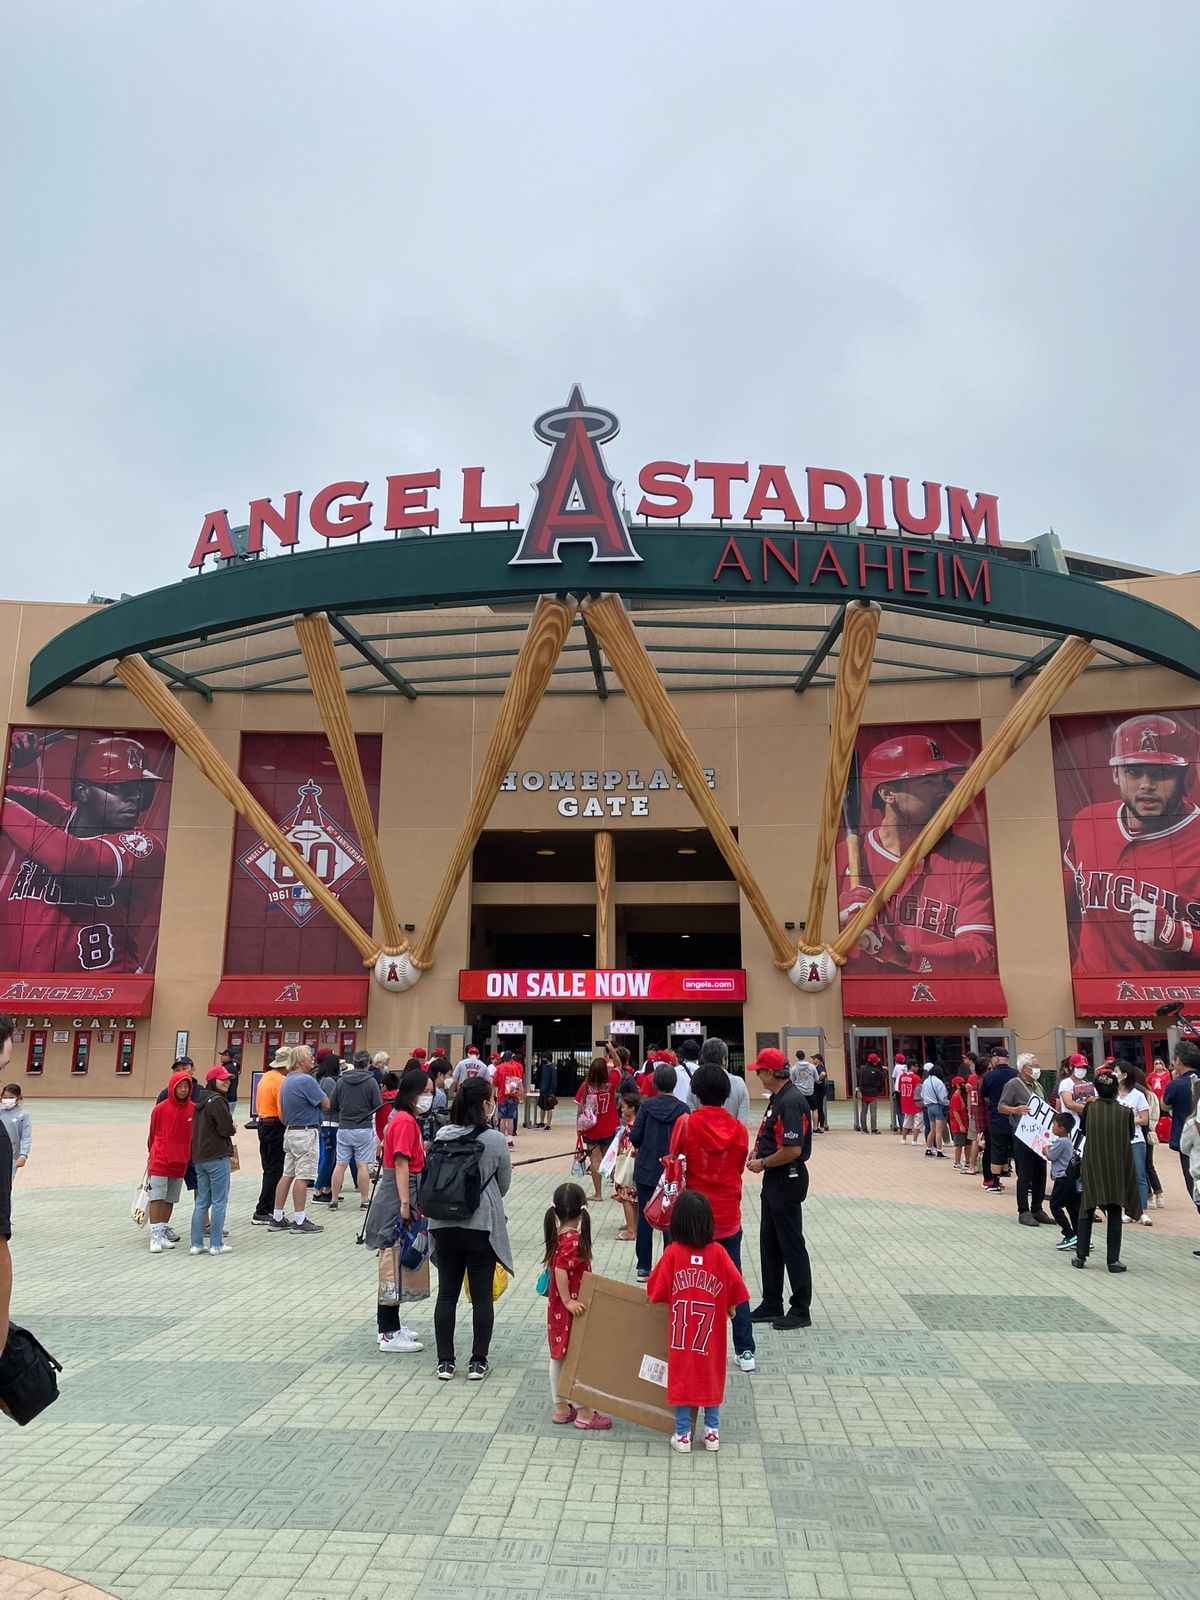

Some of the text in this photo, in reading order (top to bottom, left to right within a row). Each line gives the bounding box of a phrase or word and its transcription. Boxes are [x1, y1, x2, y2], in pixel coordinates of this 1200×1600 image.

[188, 467, 519, 568] ANGEL
[636, 459, 1002, 548] STADIUM
[713, 536, 991, 604] ANAHEIM
[557, 796, 649, 817] GATE
[245, 845, 268, 864] ANGELS
[336, 834, 366, 866] ANNIVERSARY
[268, 889, 289, 902] 1961
[876, 893, 958, 941] NGEL
[77, 924, 115, 969] 8
[1, 981, 114, 1000] ANGELS
[487, 972, 651, 997] ON SALE NOW
[685, 980, 732, 990] angels.com
[11, 1018, 135, 1029] ILL CALL
[222, 1019, 363, 1029] WILL CALL
[1094, 1020, 1154, 1030] TEAM
[671, 1300, 716, 1352] 17
